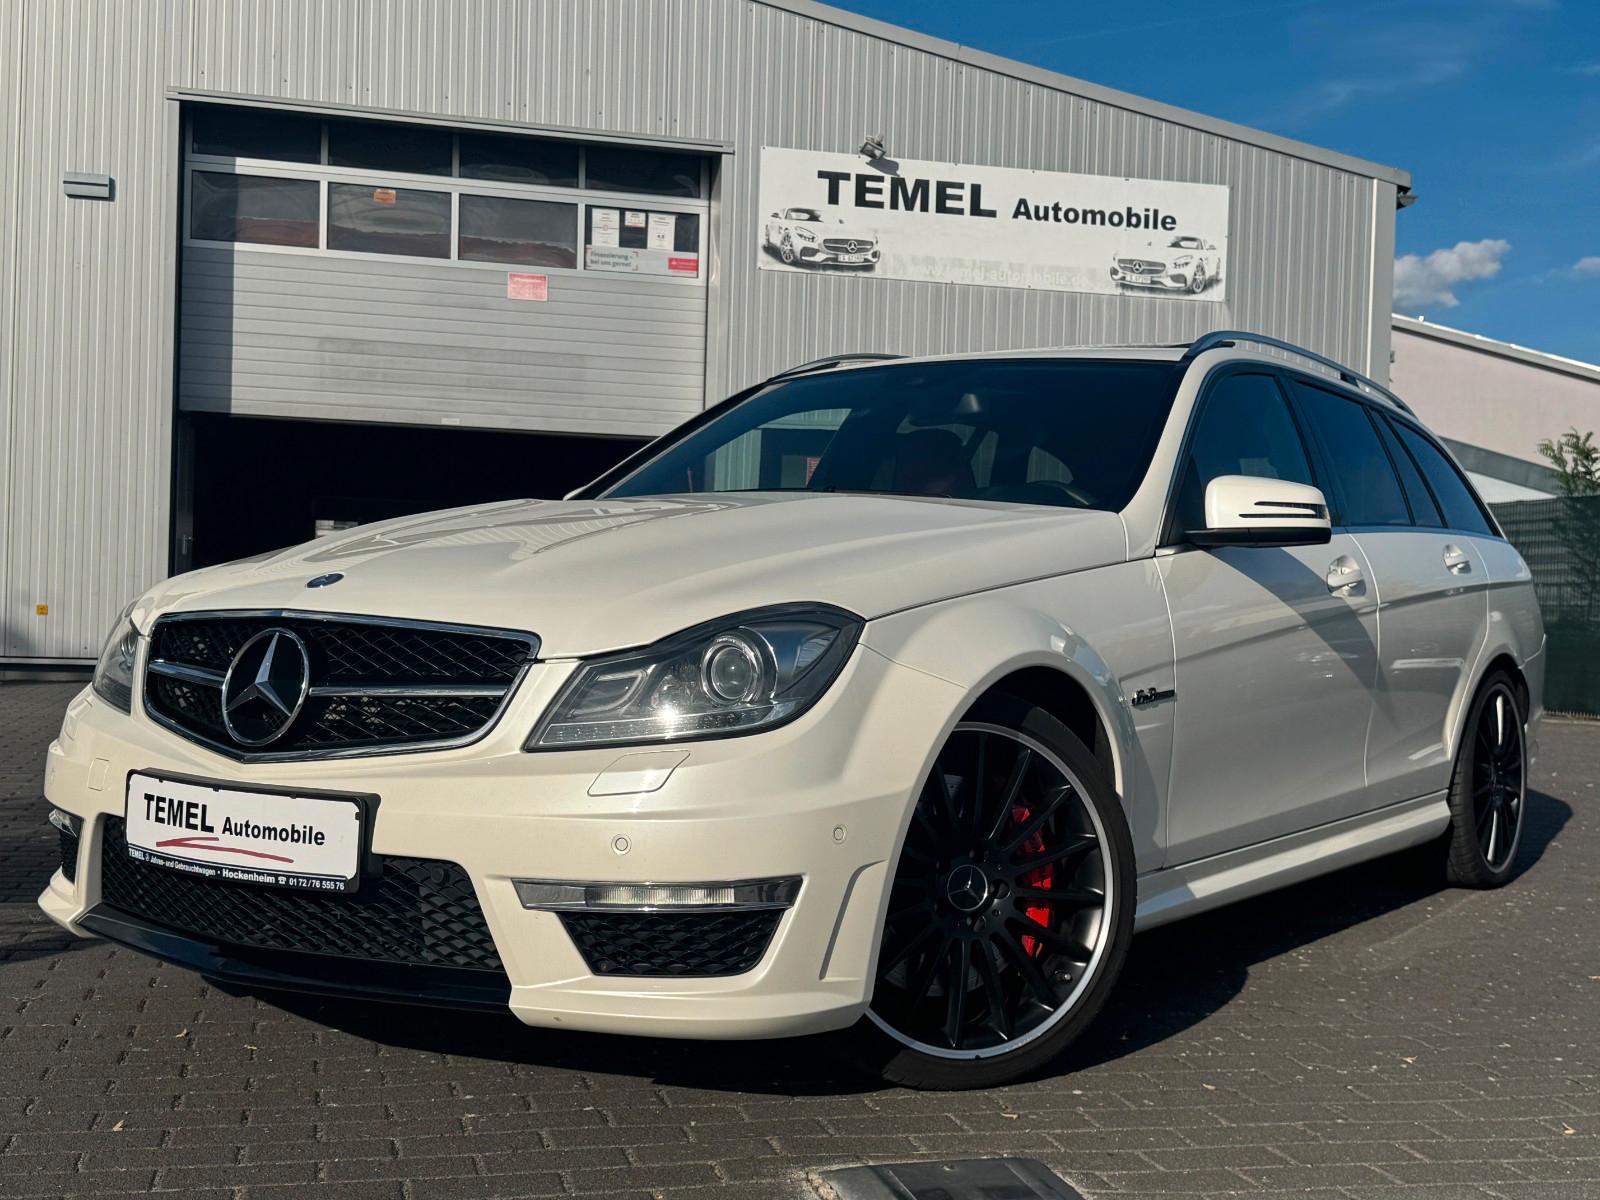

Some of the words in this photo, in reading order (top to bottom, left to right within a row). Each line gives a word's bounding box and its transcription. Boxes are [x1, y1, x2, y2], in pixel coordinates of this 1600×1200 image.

[818, 170, 998, 218] TEMEL
[1012, 198, 1178, 231] Automobile
[144, 793, 214, 833] TEMEL
[222, 816, 325, 845] Automobile
[128, 848, 145, 860] TEMEL
[174, 860, 216, 876] Gebrauchtwagen
[223, 868, 275, 883] Hockenheim
